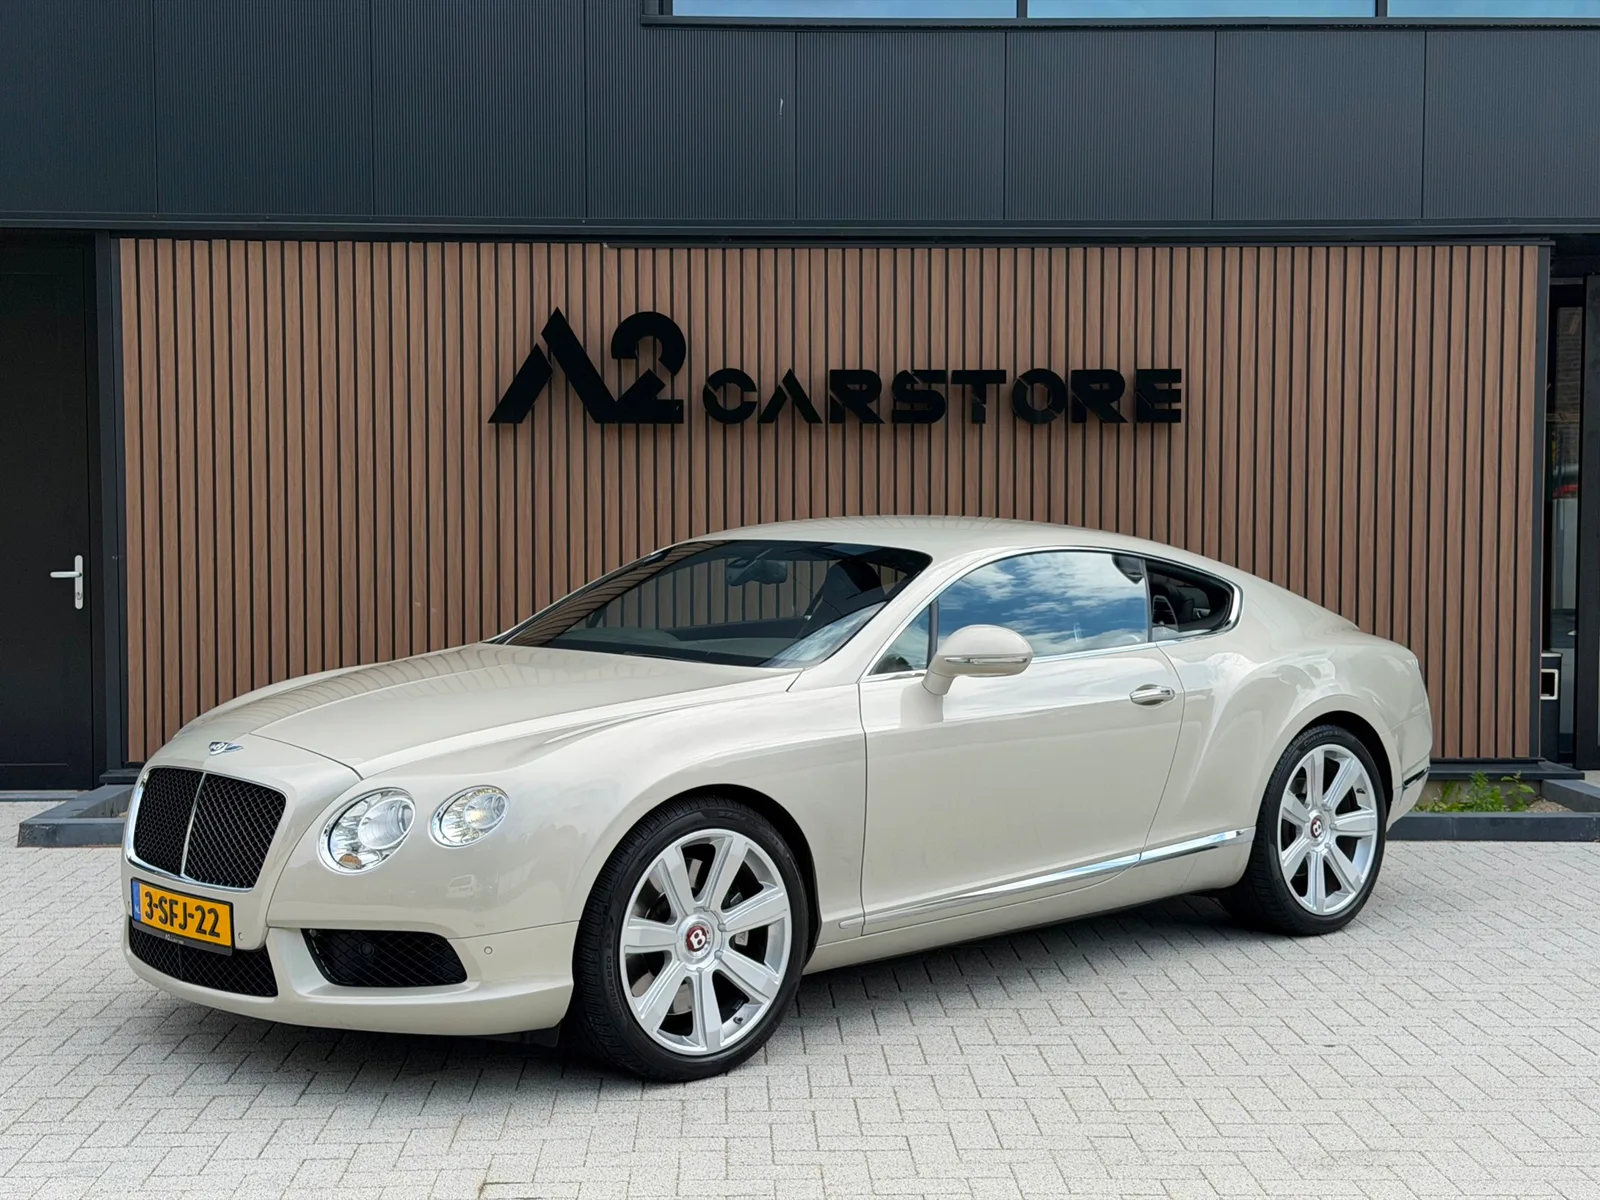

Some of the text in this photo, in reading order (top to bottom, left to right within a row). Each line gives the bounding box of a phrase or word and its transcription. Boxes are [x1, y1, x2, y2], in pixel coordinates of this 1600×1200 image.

[488, 306, 1182, 424] A2 CARSTORE
[144, 891, 221, 938] 3-SFJ-22
[690, 929, 706, 949] B
